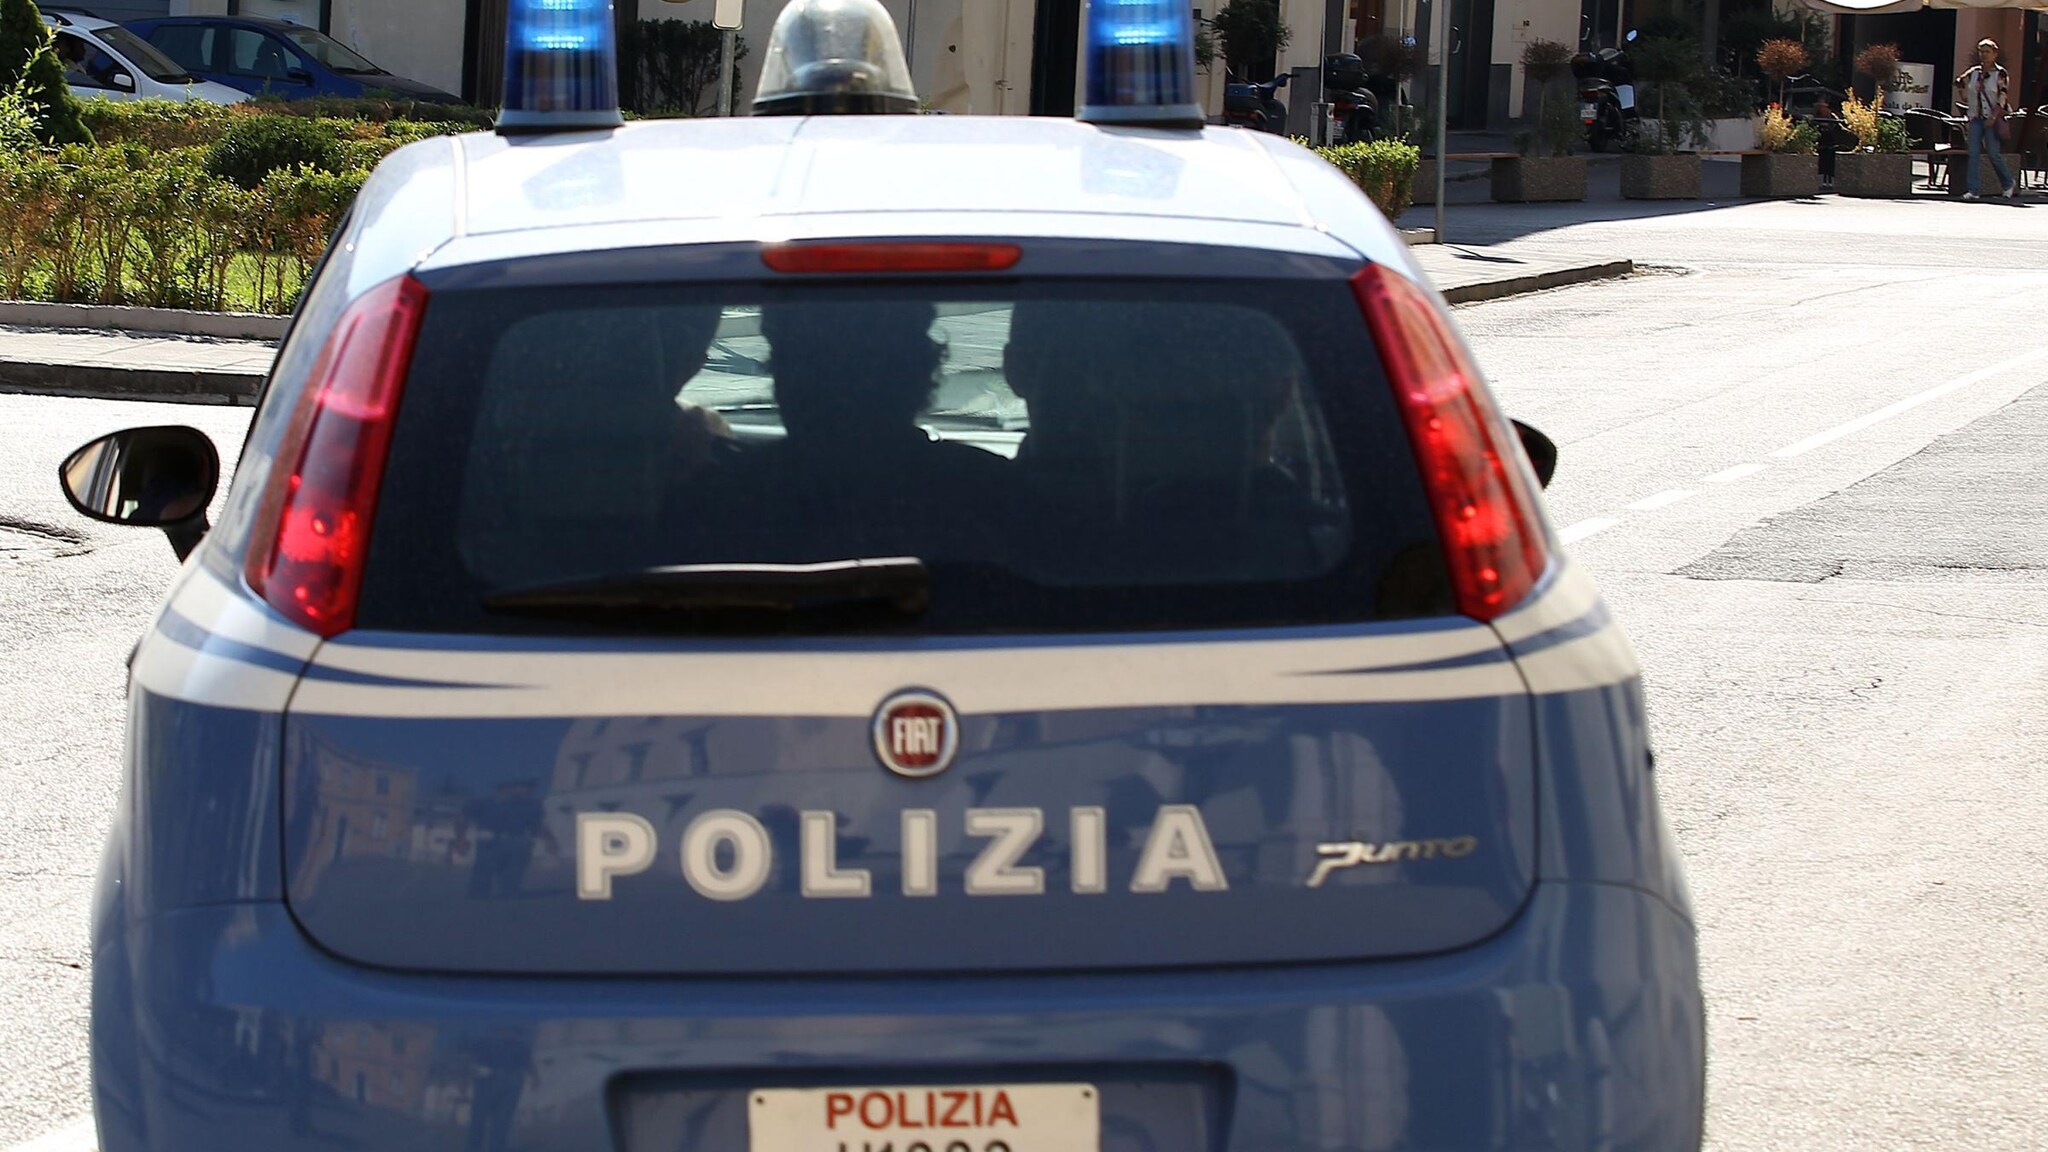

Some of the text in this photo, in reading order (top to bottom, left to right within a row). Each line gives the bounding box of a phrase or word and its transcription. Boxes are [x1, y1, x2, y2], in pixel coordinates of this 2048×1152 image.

[894, 717, 939, 754] FIAT
[576, 804, 1229, 901] POLIZIA
[826, 1089, 1019, 1129] POLIZIA
